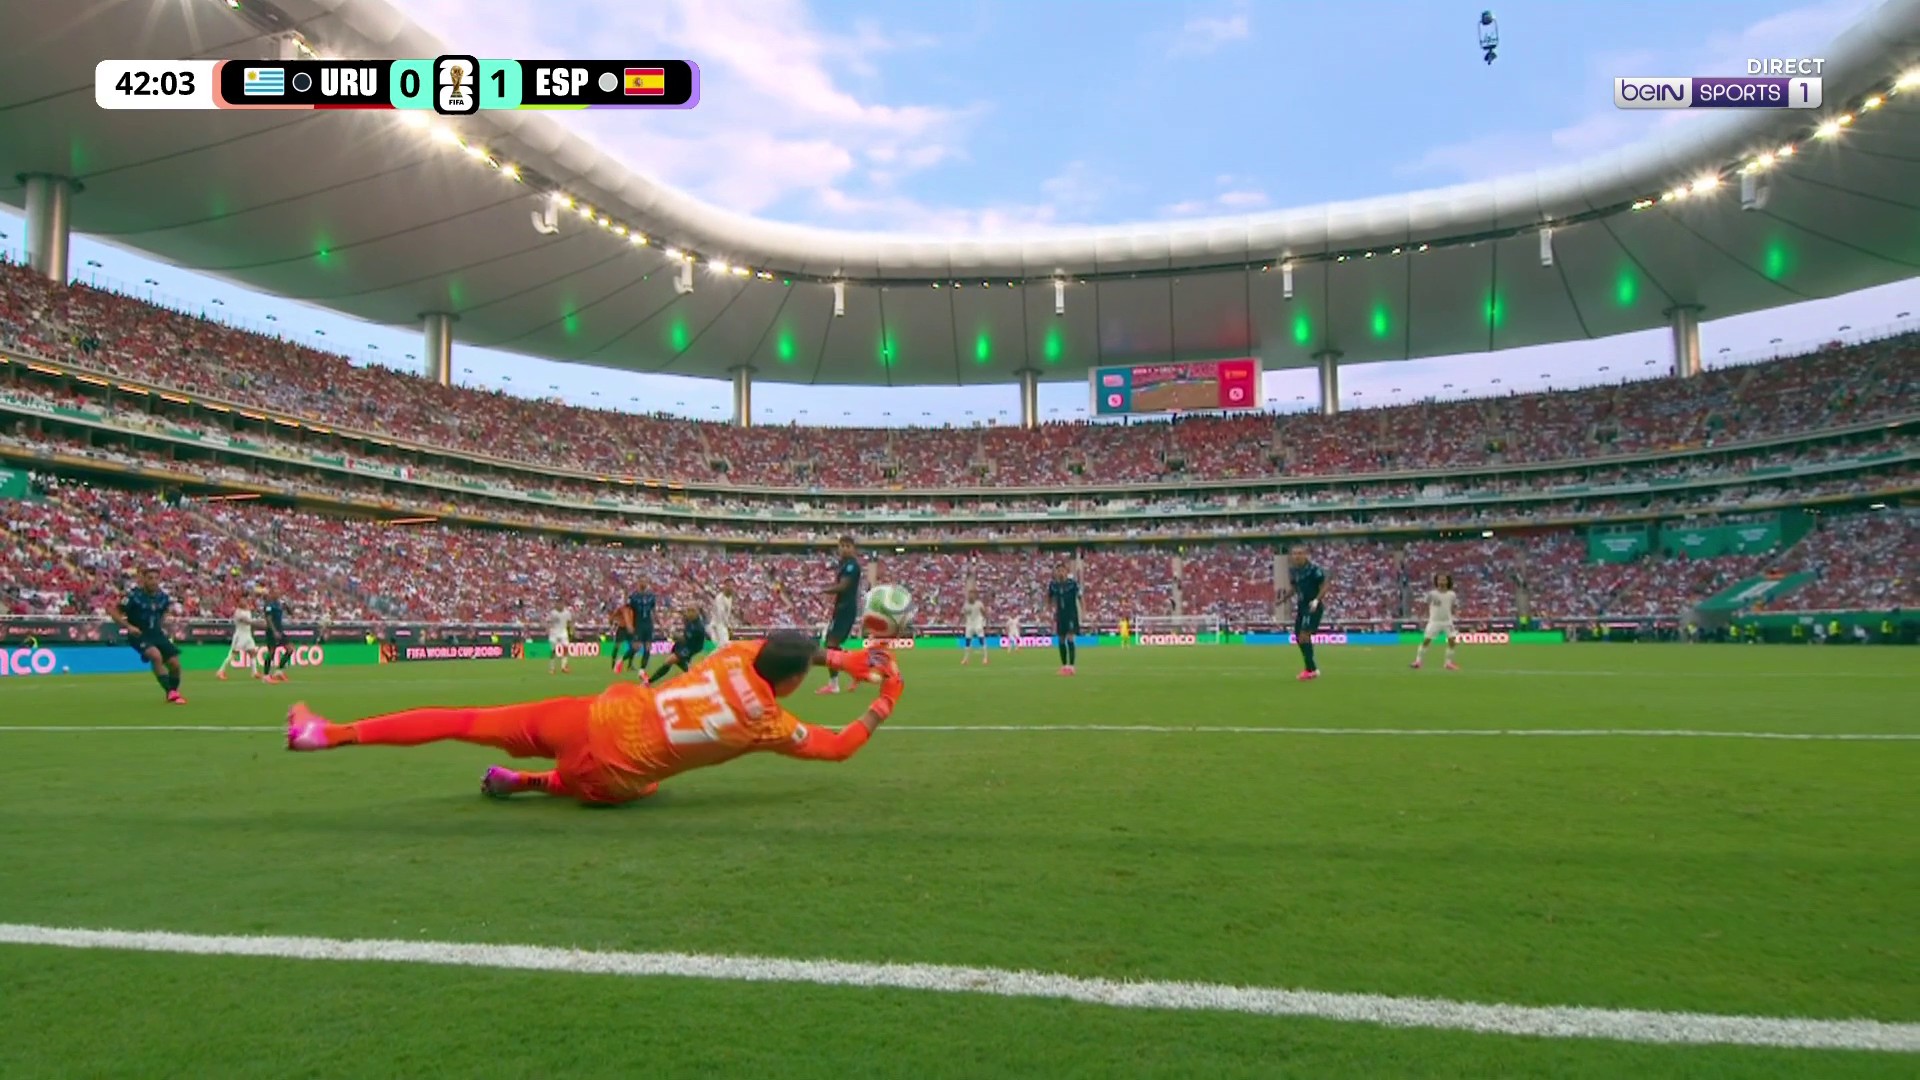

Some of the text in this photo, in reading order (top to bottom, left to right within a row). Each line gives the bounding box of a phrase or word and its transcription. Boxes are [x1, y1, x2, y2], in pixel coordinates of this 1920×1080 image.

[1140, 634, 1196, 645] aramco
[1446, 632, 1510, 644] ramco
[406, 647, 427, 659] FIFA
[427, 647, 457, 658] WORLD
[555, 642, 600, 657] aamco
[0, 648, 57, 676] co
